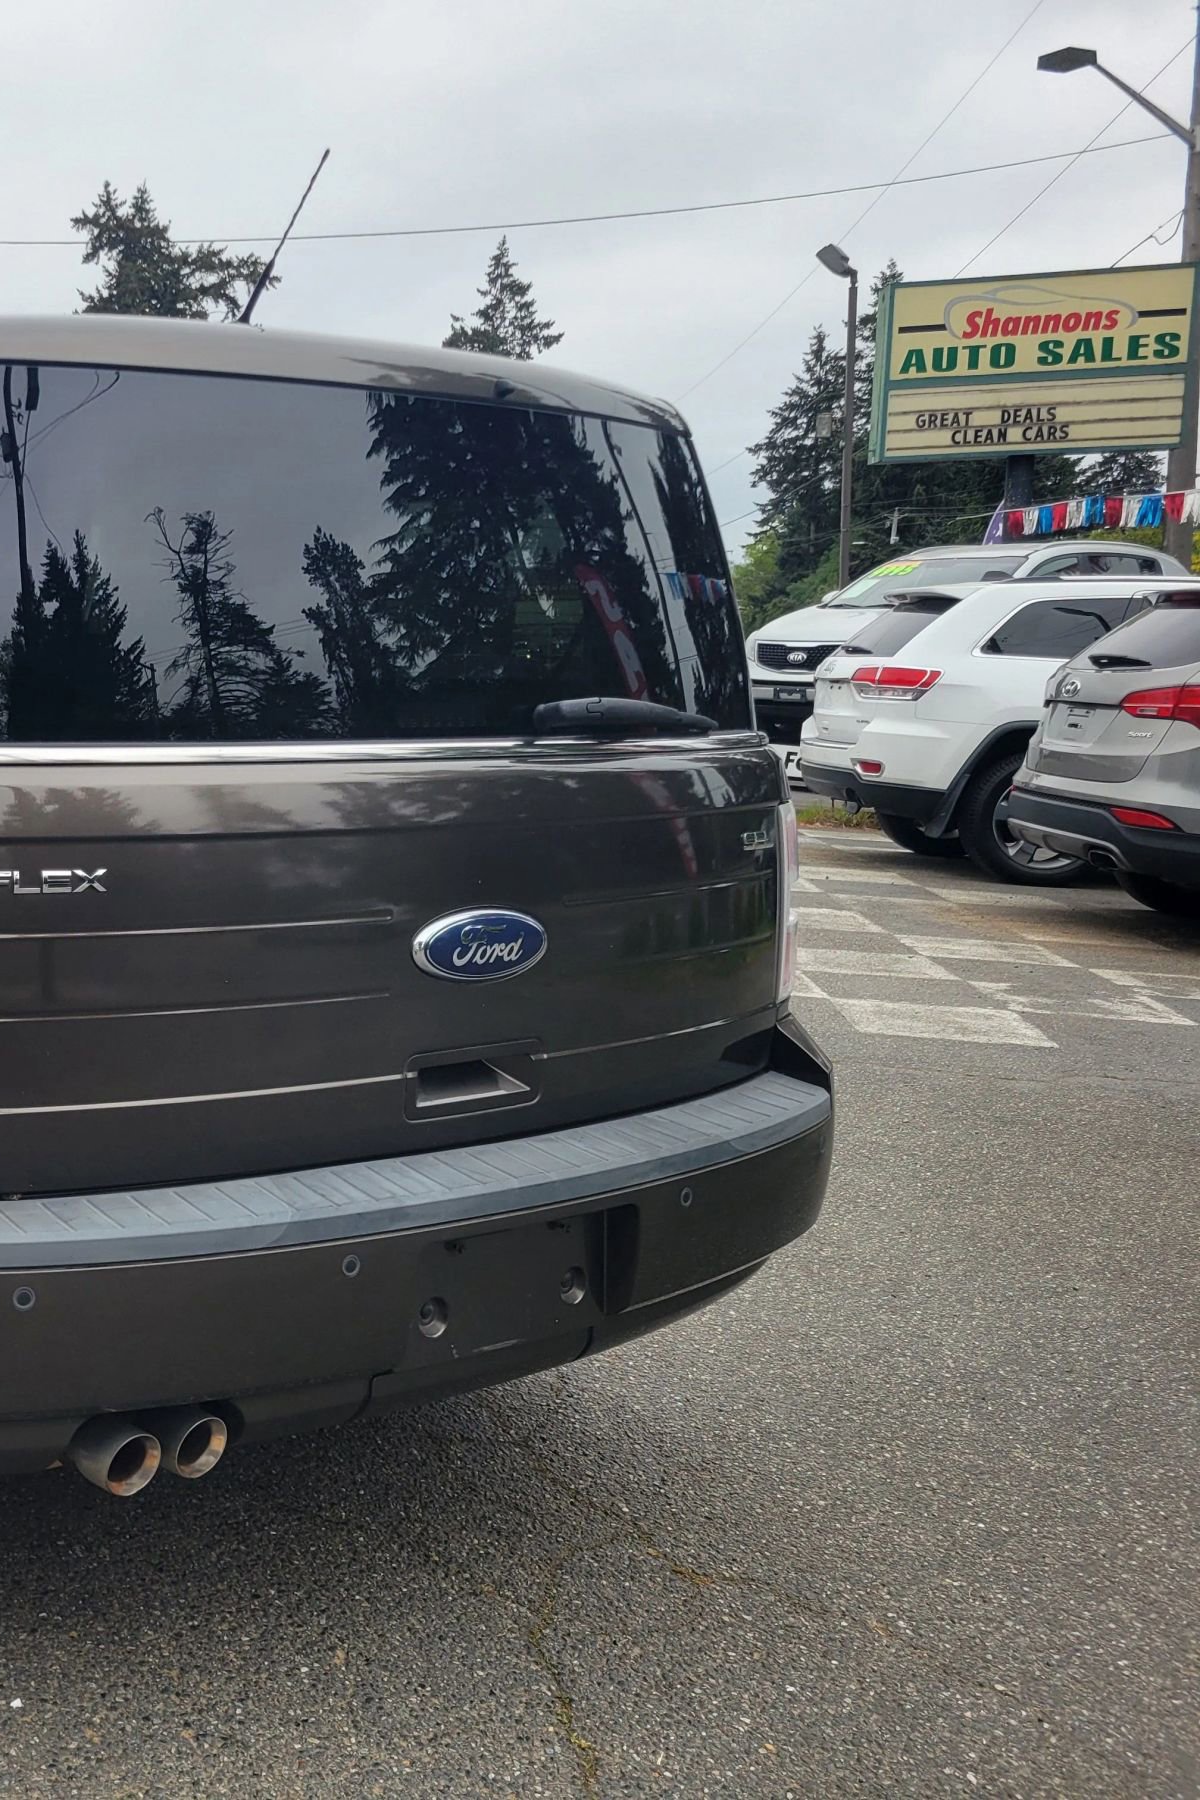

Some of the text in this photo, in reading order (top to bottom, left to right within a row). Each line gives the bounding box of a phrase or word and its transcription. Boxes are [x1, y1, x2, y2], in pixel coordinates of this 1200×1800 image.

[962, 307, 1121, 340] Shannons
[898, 332, 1182, 374] AUTO SALES
[915, 406, 1057, 430] GREAT DEALS
[951, 424, 1070, 446] CLEAN CARS
[452, 924, 525, 967] Ford
